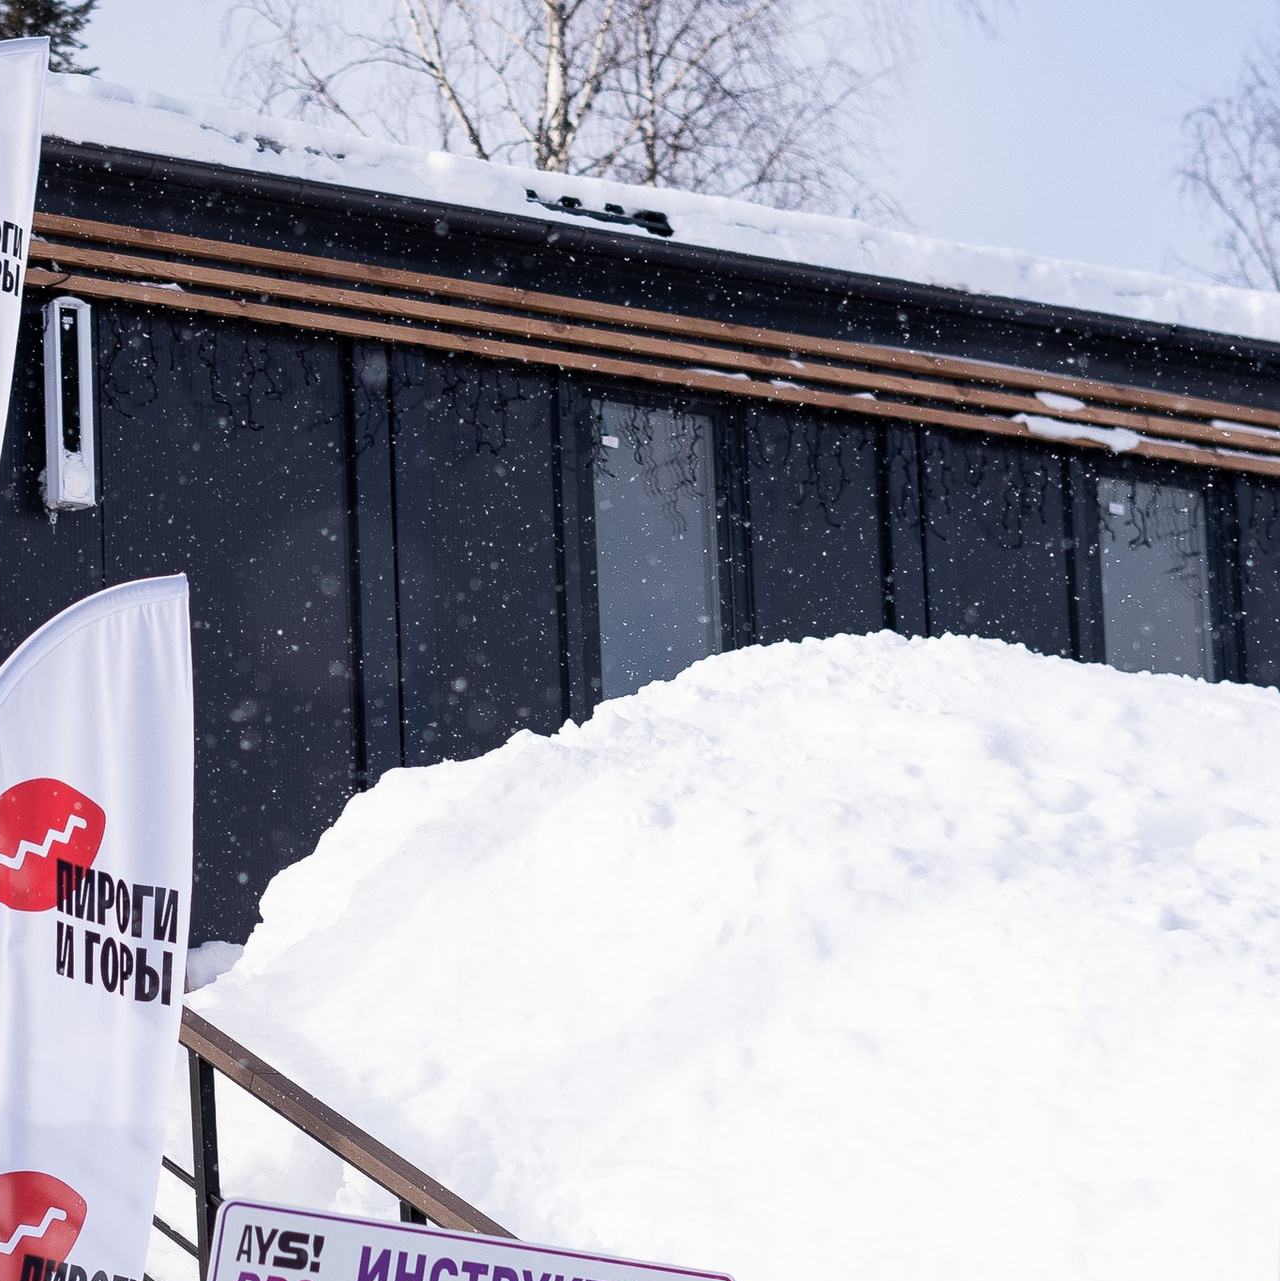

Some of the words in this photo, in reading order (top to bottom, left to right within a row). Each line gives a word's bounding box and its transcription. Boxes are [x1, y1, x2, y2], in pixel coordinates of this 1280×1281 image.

[56, 858, 179, 944] ПИРОГИ
[56, 920, 74, 979] И
[84, 929, 173, 1006] ГОРЫ
[235, 1224, 325, 1273] AYS!
